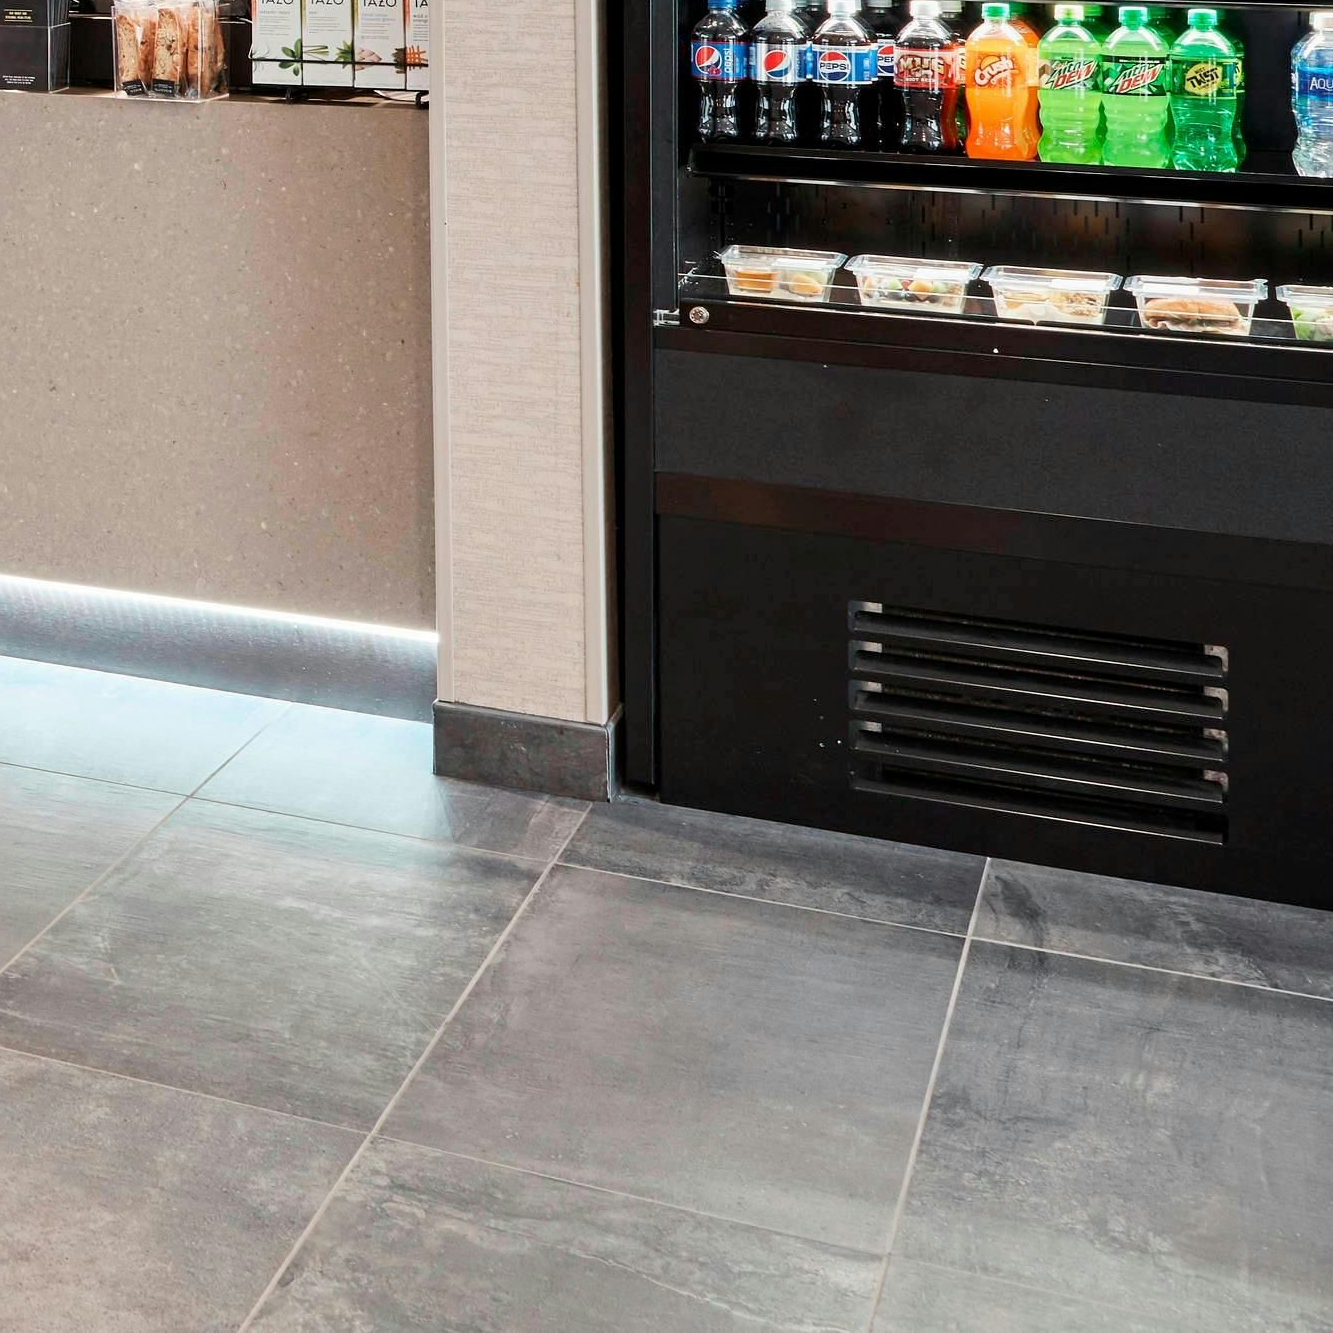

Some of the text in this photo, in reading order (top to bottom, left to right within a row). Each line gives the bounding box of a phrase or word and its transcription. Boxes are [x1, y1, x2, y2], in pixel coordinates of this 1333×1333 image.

[819, 63, 850, 72] PEPSI
[899, 56, 945, 75] MUG
[974, 55, 1014, 87] Crush
[1055, 65, 1094, 88] DEW
[1118, 67, 1159, 93] DEW
